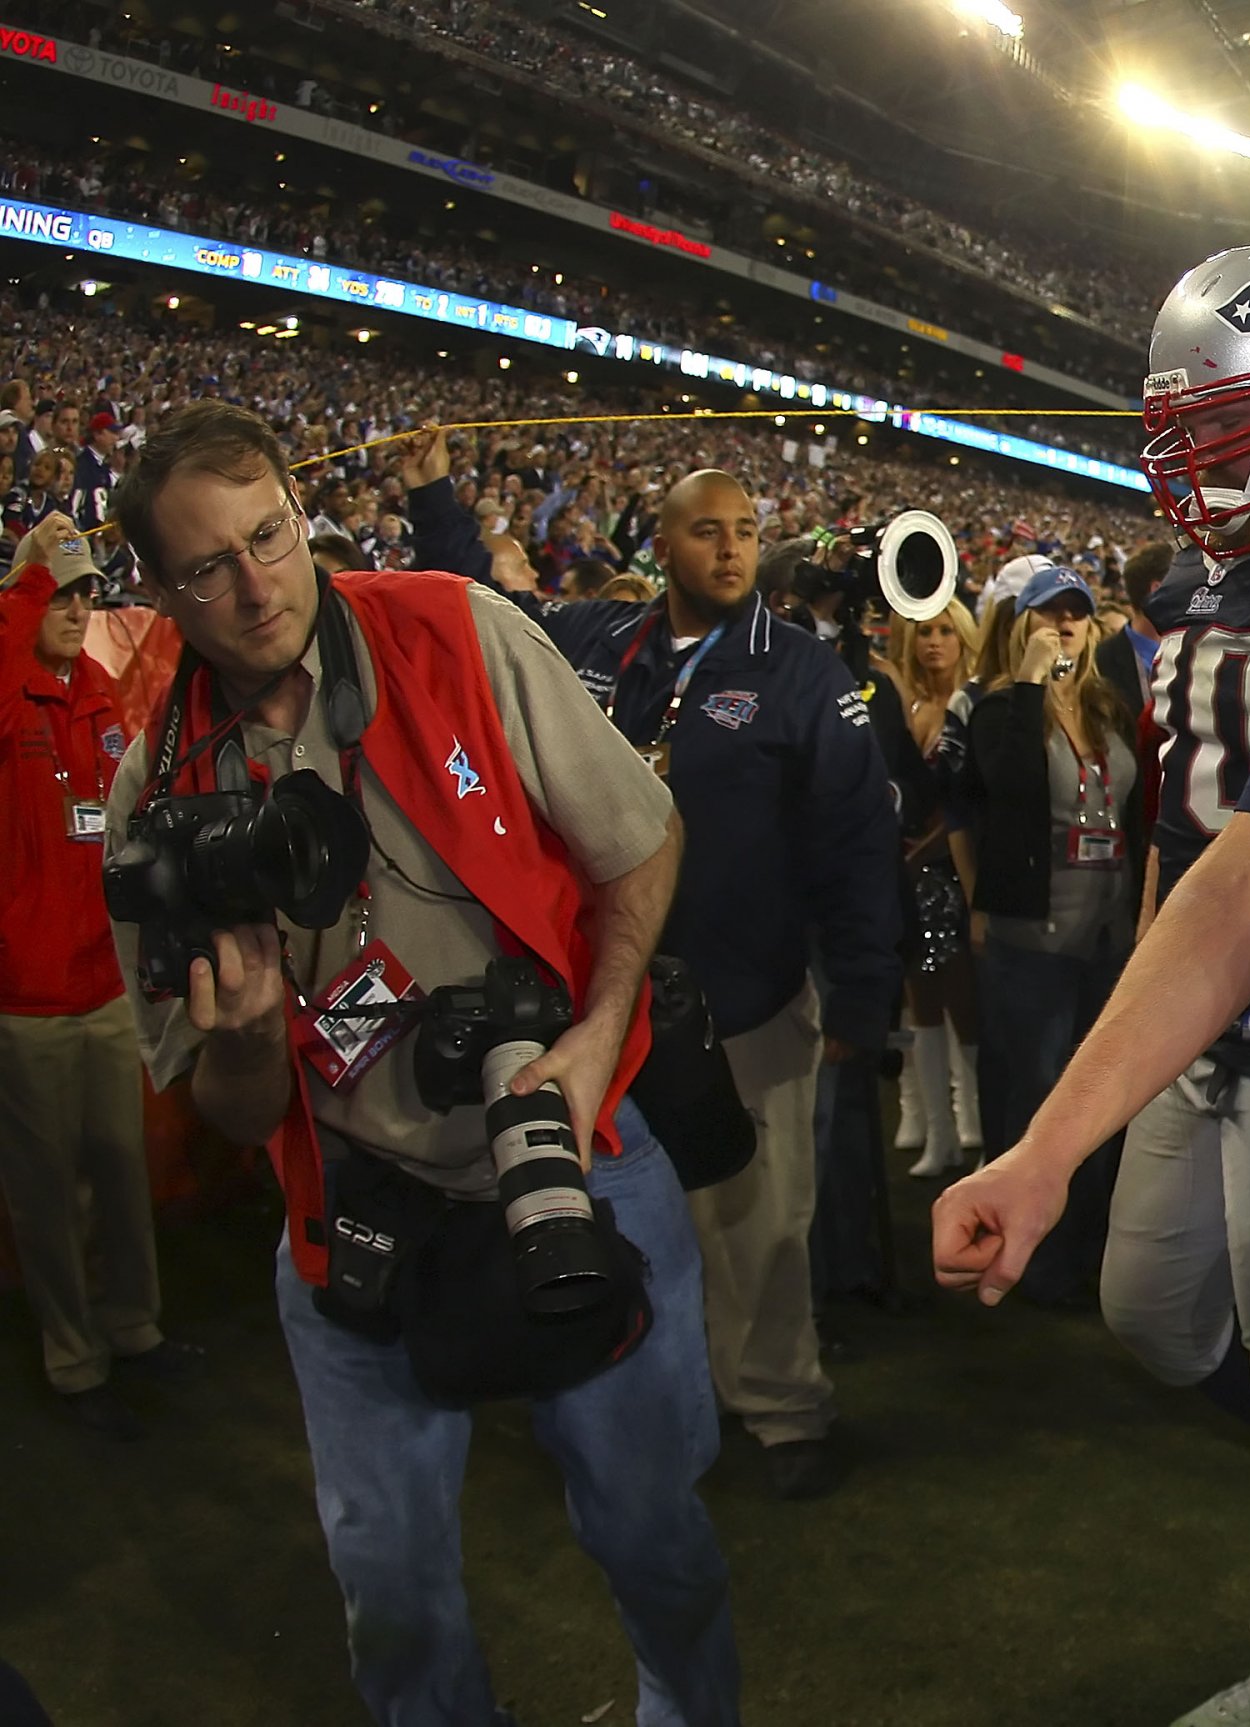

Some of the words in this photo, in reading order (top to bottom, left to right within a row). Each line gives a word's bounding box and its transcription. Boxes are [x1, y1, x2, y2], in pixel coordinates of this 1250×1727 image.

[101, 57, 178, 97] TOYOTA
[211, 83, 277, 122] Insight
[88, 228, 115, 249] QB
[197, 249, 240, 268] COMP
[327, 980, 350, 1003] MEDIA
[336, 1217, 395, 1252] CPS
